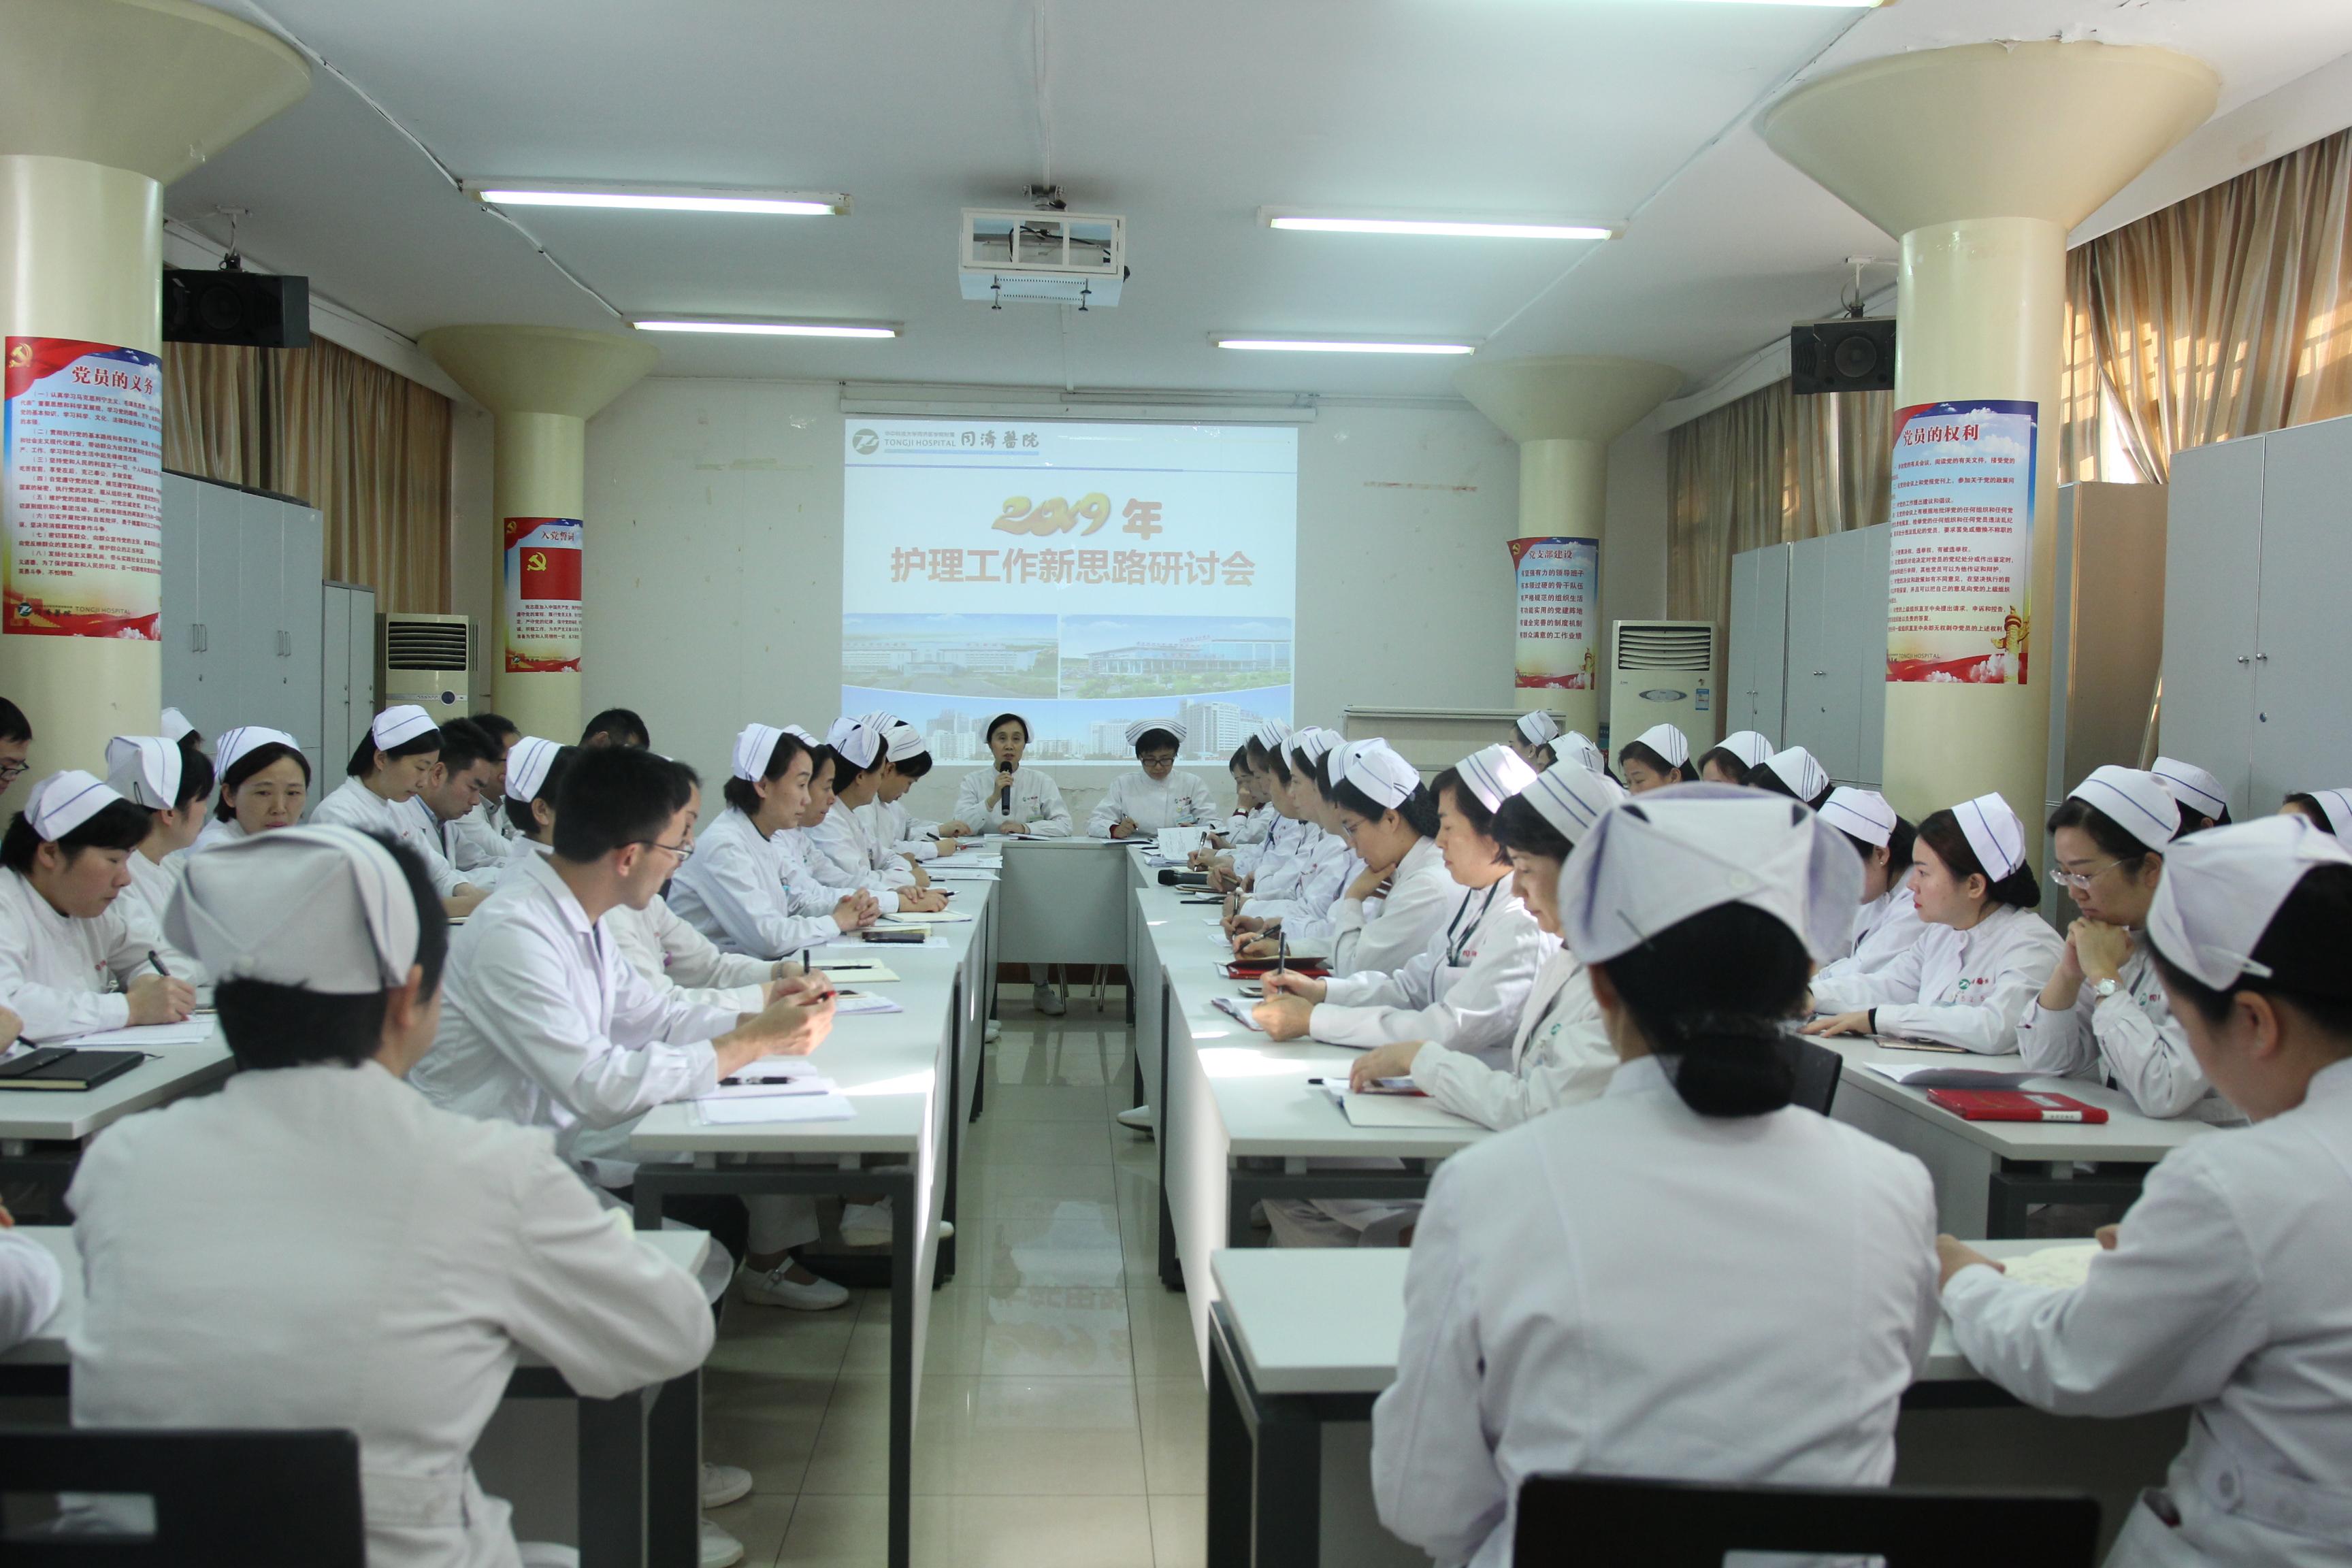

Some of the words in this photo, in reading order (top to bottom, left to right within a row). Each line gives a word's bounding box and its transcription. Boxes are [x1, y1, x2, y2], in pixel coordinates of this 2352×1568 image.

[72, 366, 153, 395] 党员的义务
[1904, 425, 1979, 446] 党员的权利
[916, 439, 956, 447] HOSPITAL
[541, 530, 574, 542] 入党誓词
[1529, 550, 1573, 559] 党支部建设
[891, 547, 1255, 587] 护理工作新思路研讨会
[1521, 569, 1584, 578] 有坚强有力的领导班子
[1521, 594, 1583, 602] 有严格规范的组织生活
[1520, 606, 1582, 615] 有功能实用的党建阵地
[1520, 619, 1582, 627] 有健全完善的制度机制
[1520, 632, 1582, 640] 有群众满意的工作业绩
